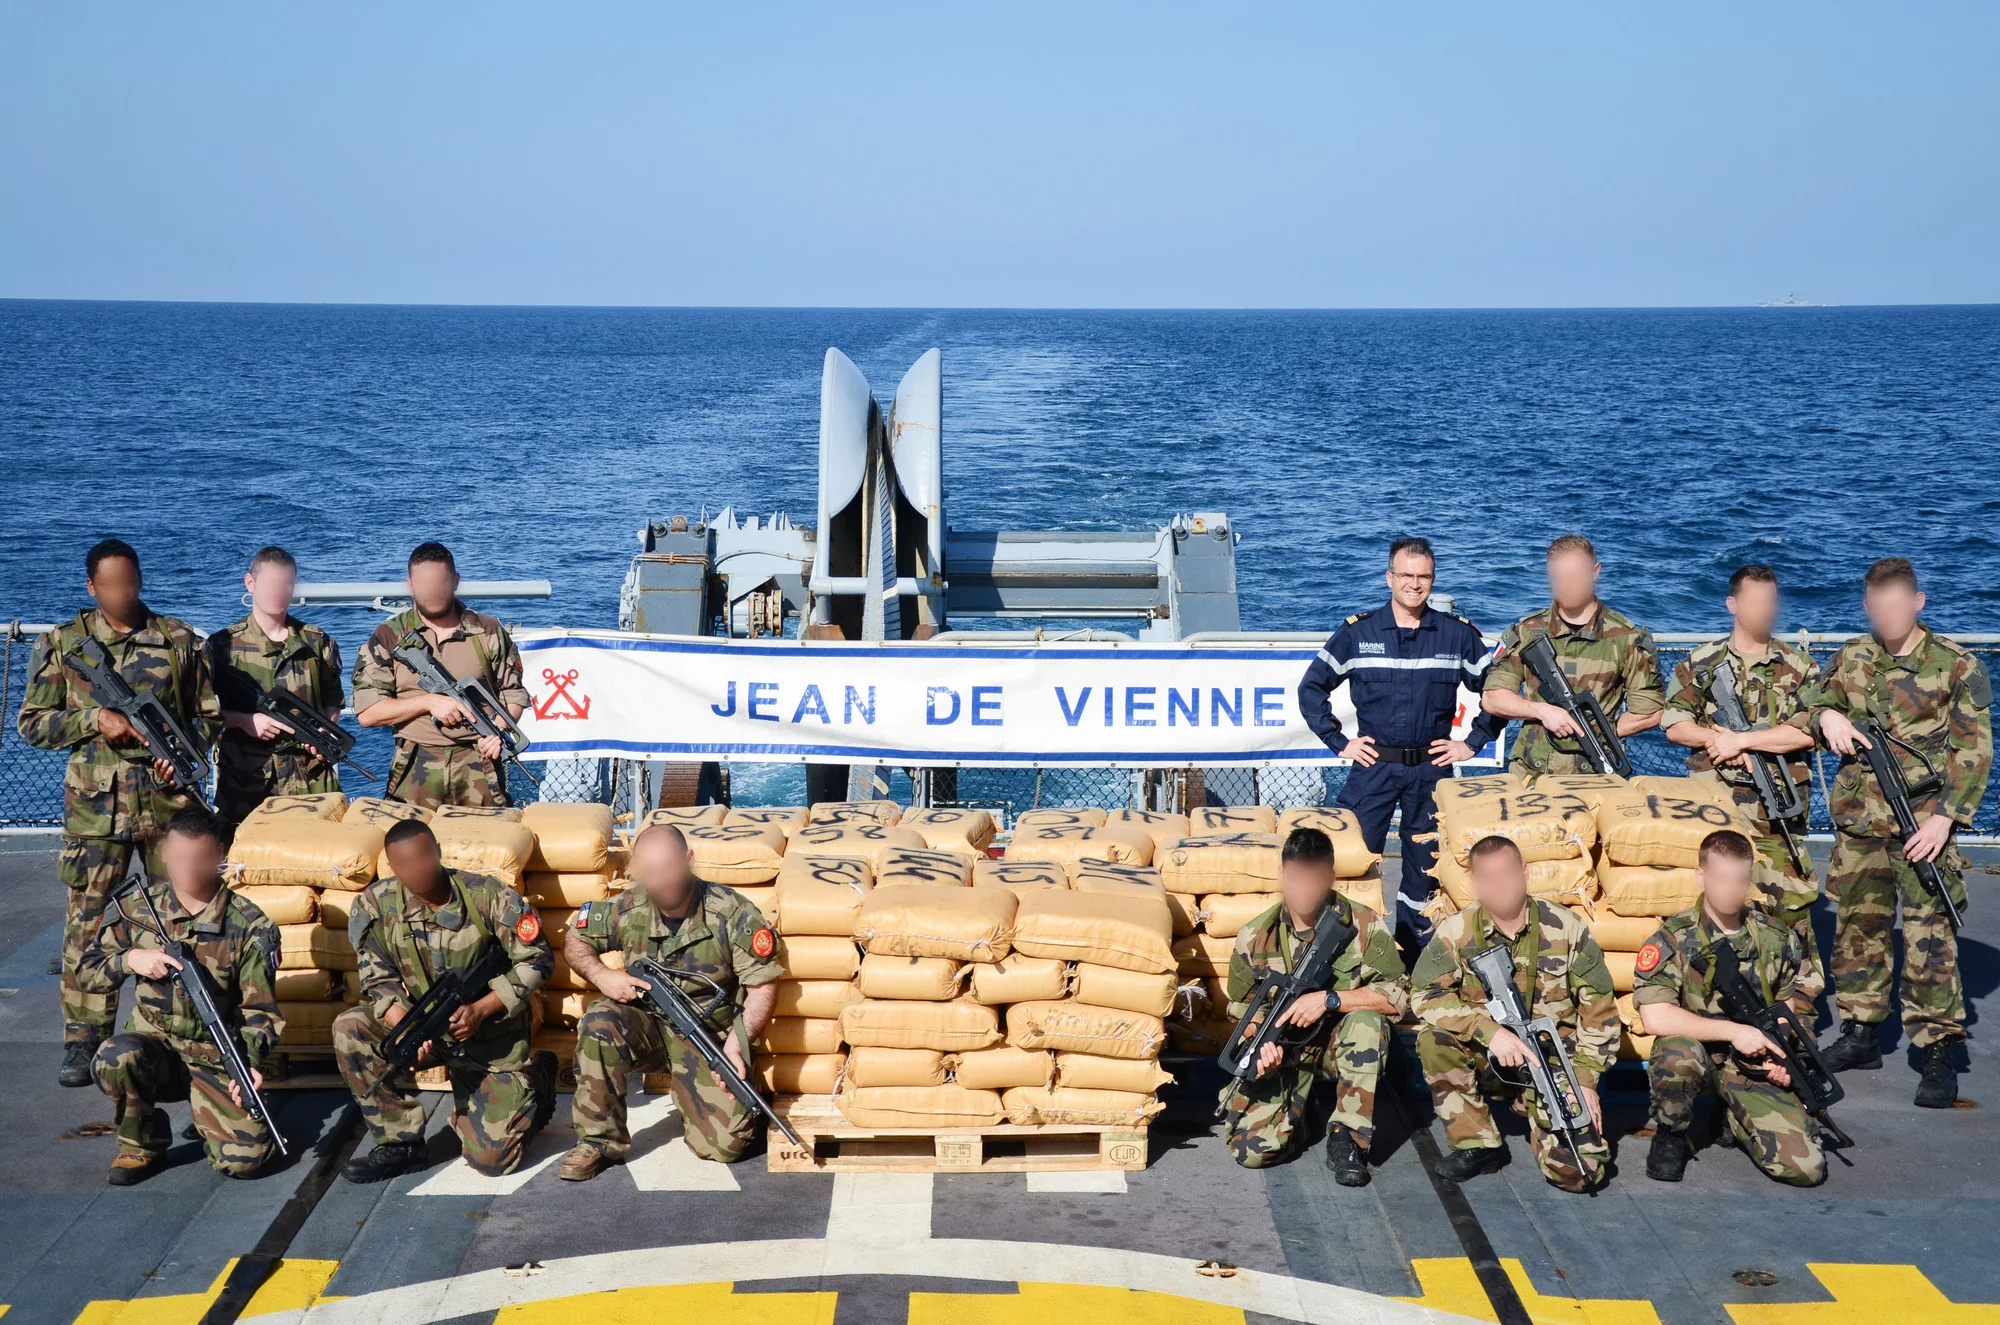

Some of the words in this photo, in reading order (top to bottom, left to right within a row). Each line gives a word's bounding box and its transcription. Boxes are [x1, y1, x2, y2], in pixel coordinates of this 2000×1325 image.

[1358, 641, 1385, 649] MARINE
[711, 680, 876, 725] JEAN
[926, 686, 1003, 726] DE
[1055, 687, 1285, 727] VIENNE
[1499, 793, 1590, 821] 137
[1647, 794, 1732, 826] 130
[804, 856, 865, 886] 150
